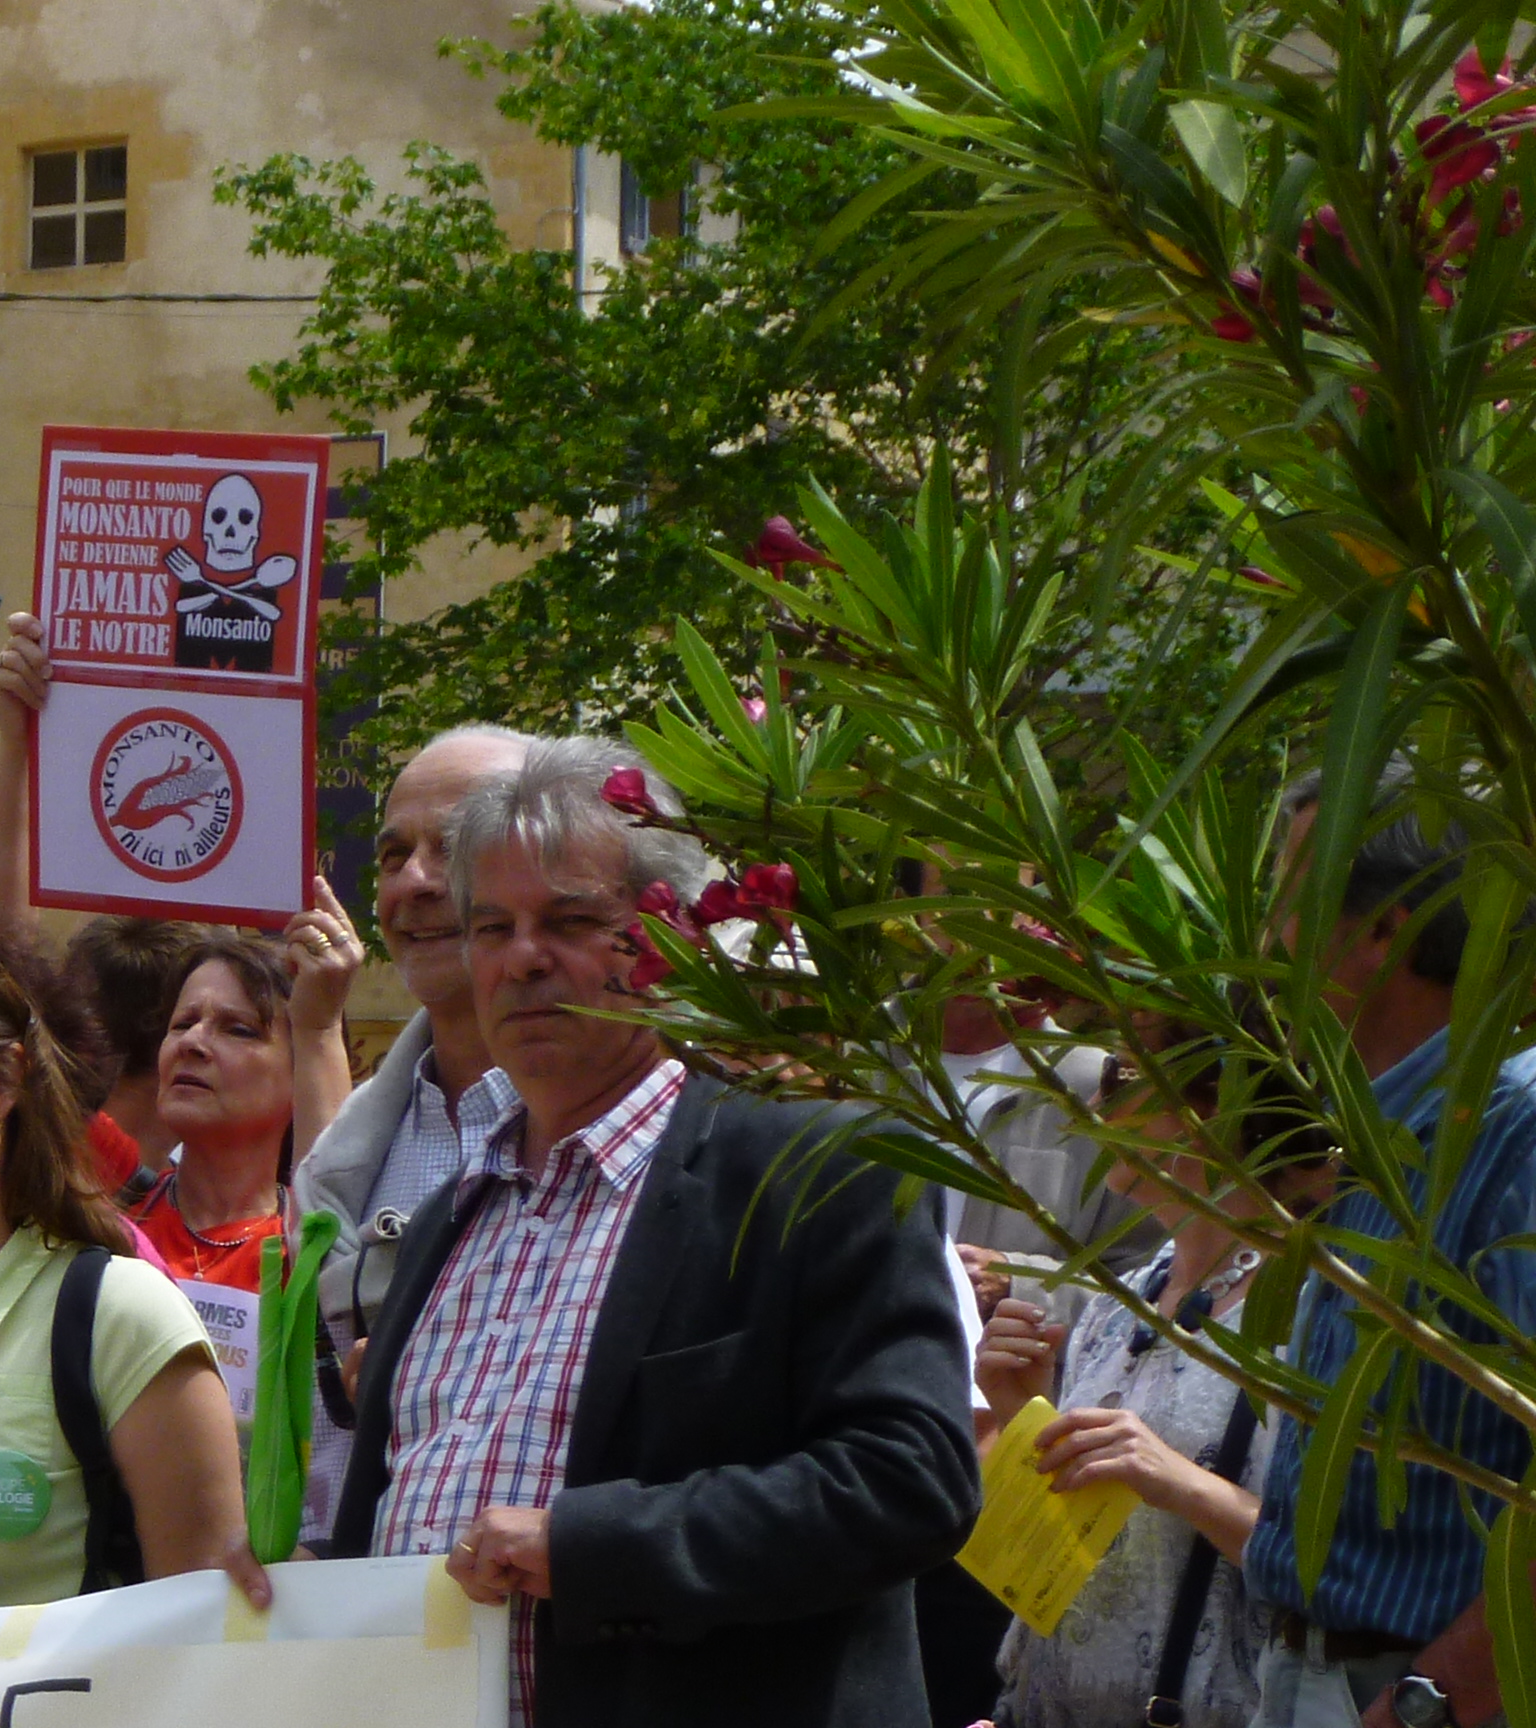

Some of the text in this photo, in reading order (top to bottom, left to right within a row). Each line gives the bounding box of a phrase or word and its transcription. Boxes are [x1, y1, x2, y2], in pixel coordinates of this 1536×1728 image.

[62, 477, 203, 503] POUR QUE LE MONDE
[59, 502, 192, 541] MONSANTO
[59, 540, 158, 567] NE DEVIENNE
[54, 567, 169, 617] JAMAIS
[53, 617, 170, 657] LE NOTRE
[185, 612, 271, 642] Monsanto
[103, 723, 215, 808] MONSANTO
[120, 786, 231, 867] ni ici ni ailleurs
